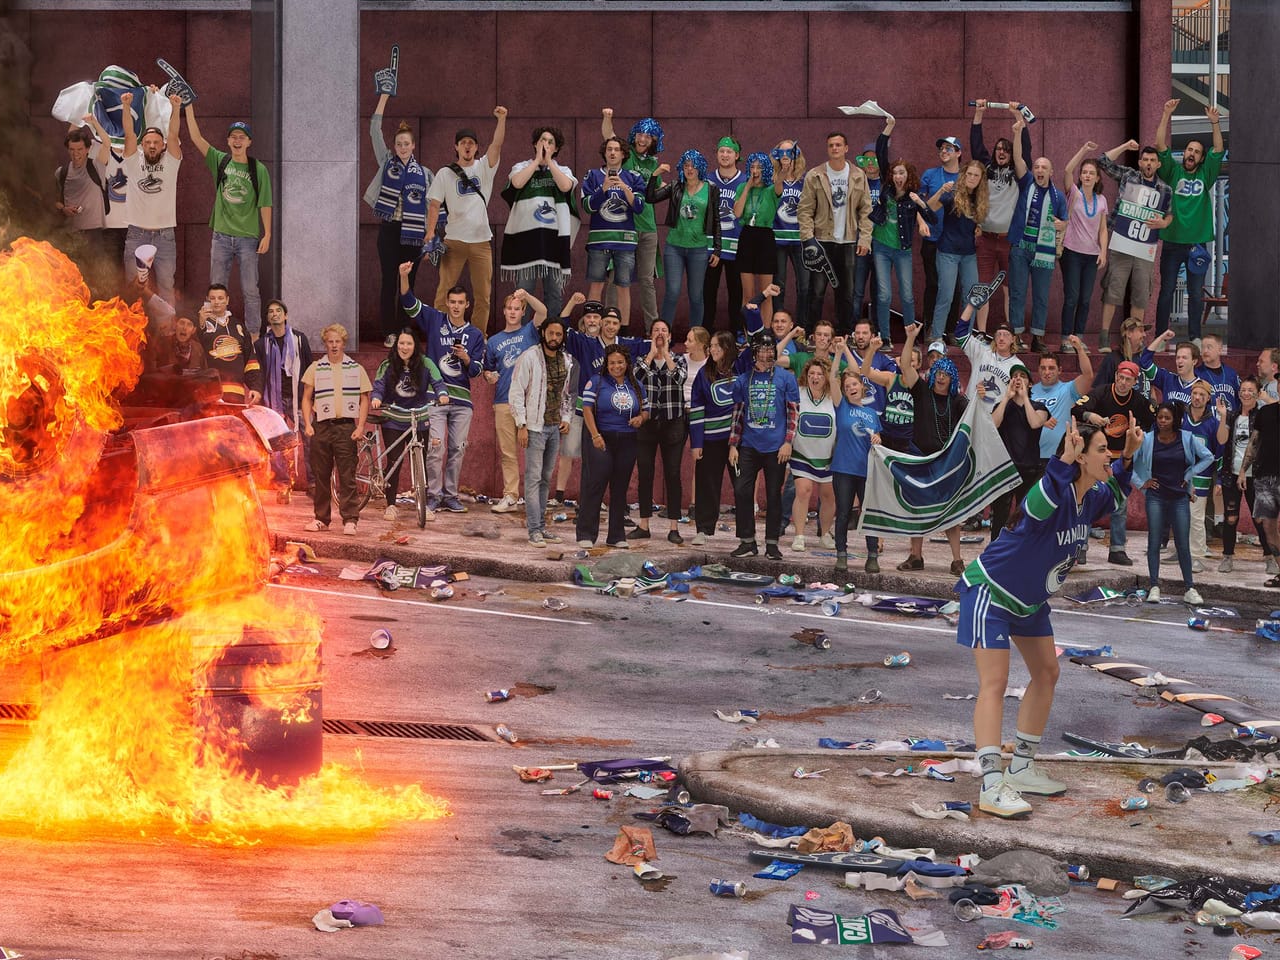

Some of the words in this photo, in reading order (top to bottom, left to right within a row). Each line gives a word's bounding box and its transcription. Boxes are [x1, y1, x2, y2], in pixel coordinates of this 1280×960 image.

[1137, 187, 1161, 209] GO
[1122, 203, 1155, 221] CANUC
[1127, 220, 1151, 242] GO
[461, 333, 469, 345] C
[849, 408, 874, 423] CANUCKS
